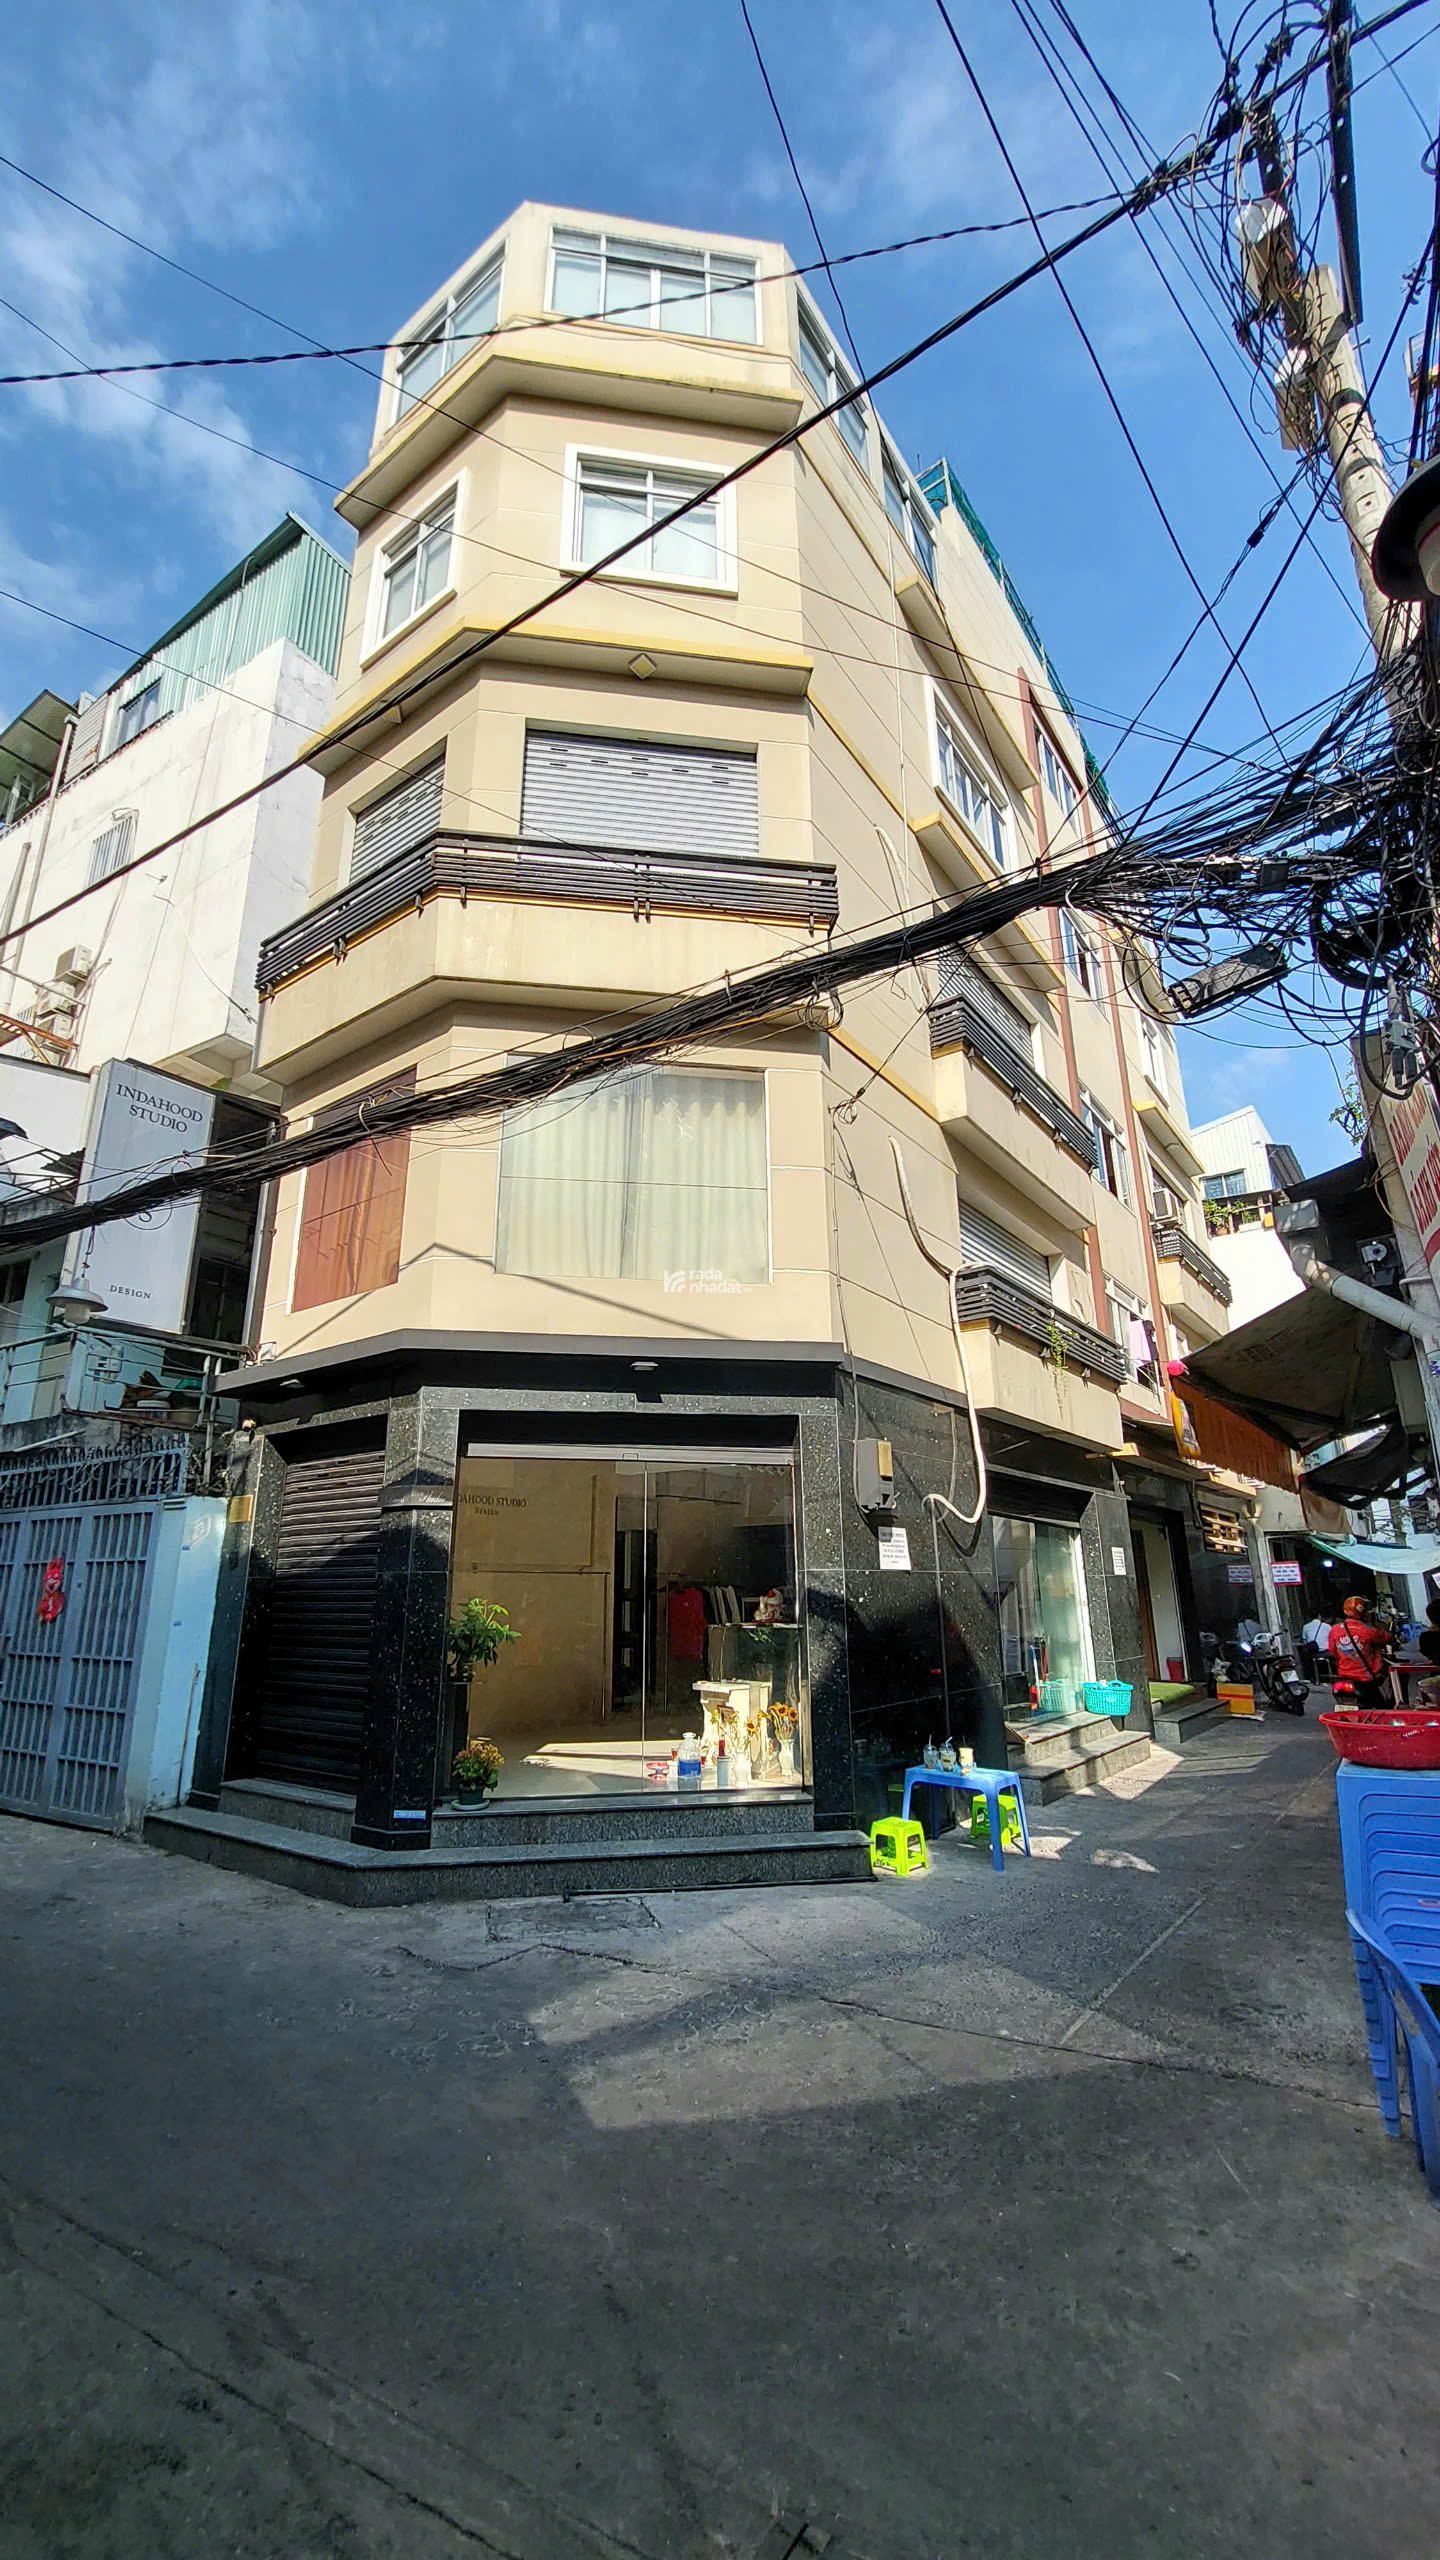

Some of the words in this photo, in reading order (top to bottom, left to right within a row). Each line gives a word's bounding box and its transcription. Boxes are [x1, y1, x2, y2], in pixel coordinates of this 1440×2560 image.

[116, 1083, 203, 1122] INDAHOOD
[129, 1104, 188, 1133] STUDIO
[110, 1284, 151, 1300] DESIGN
